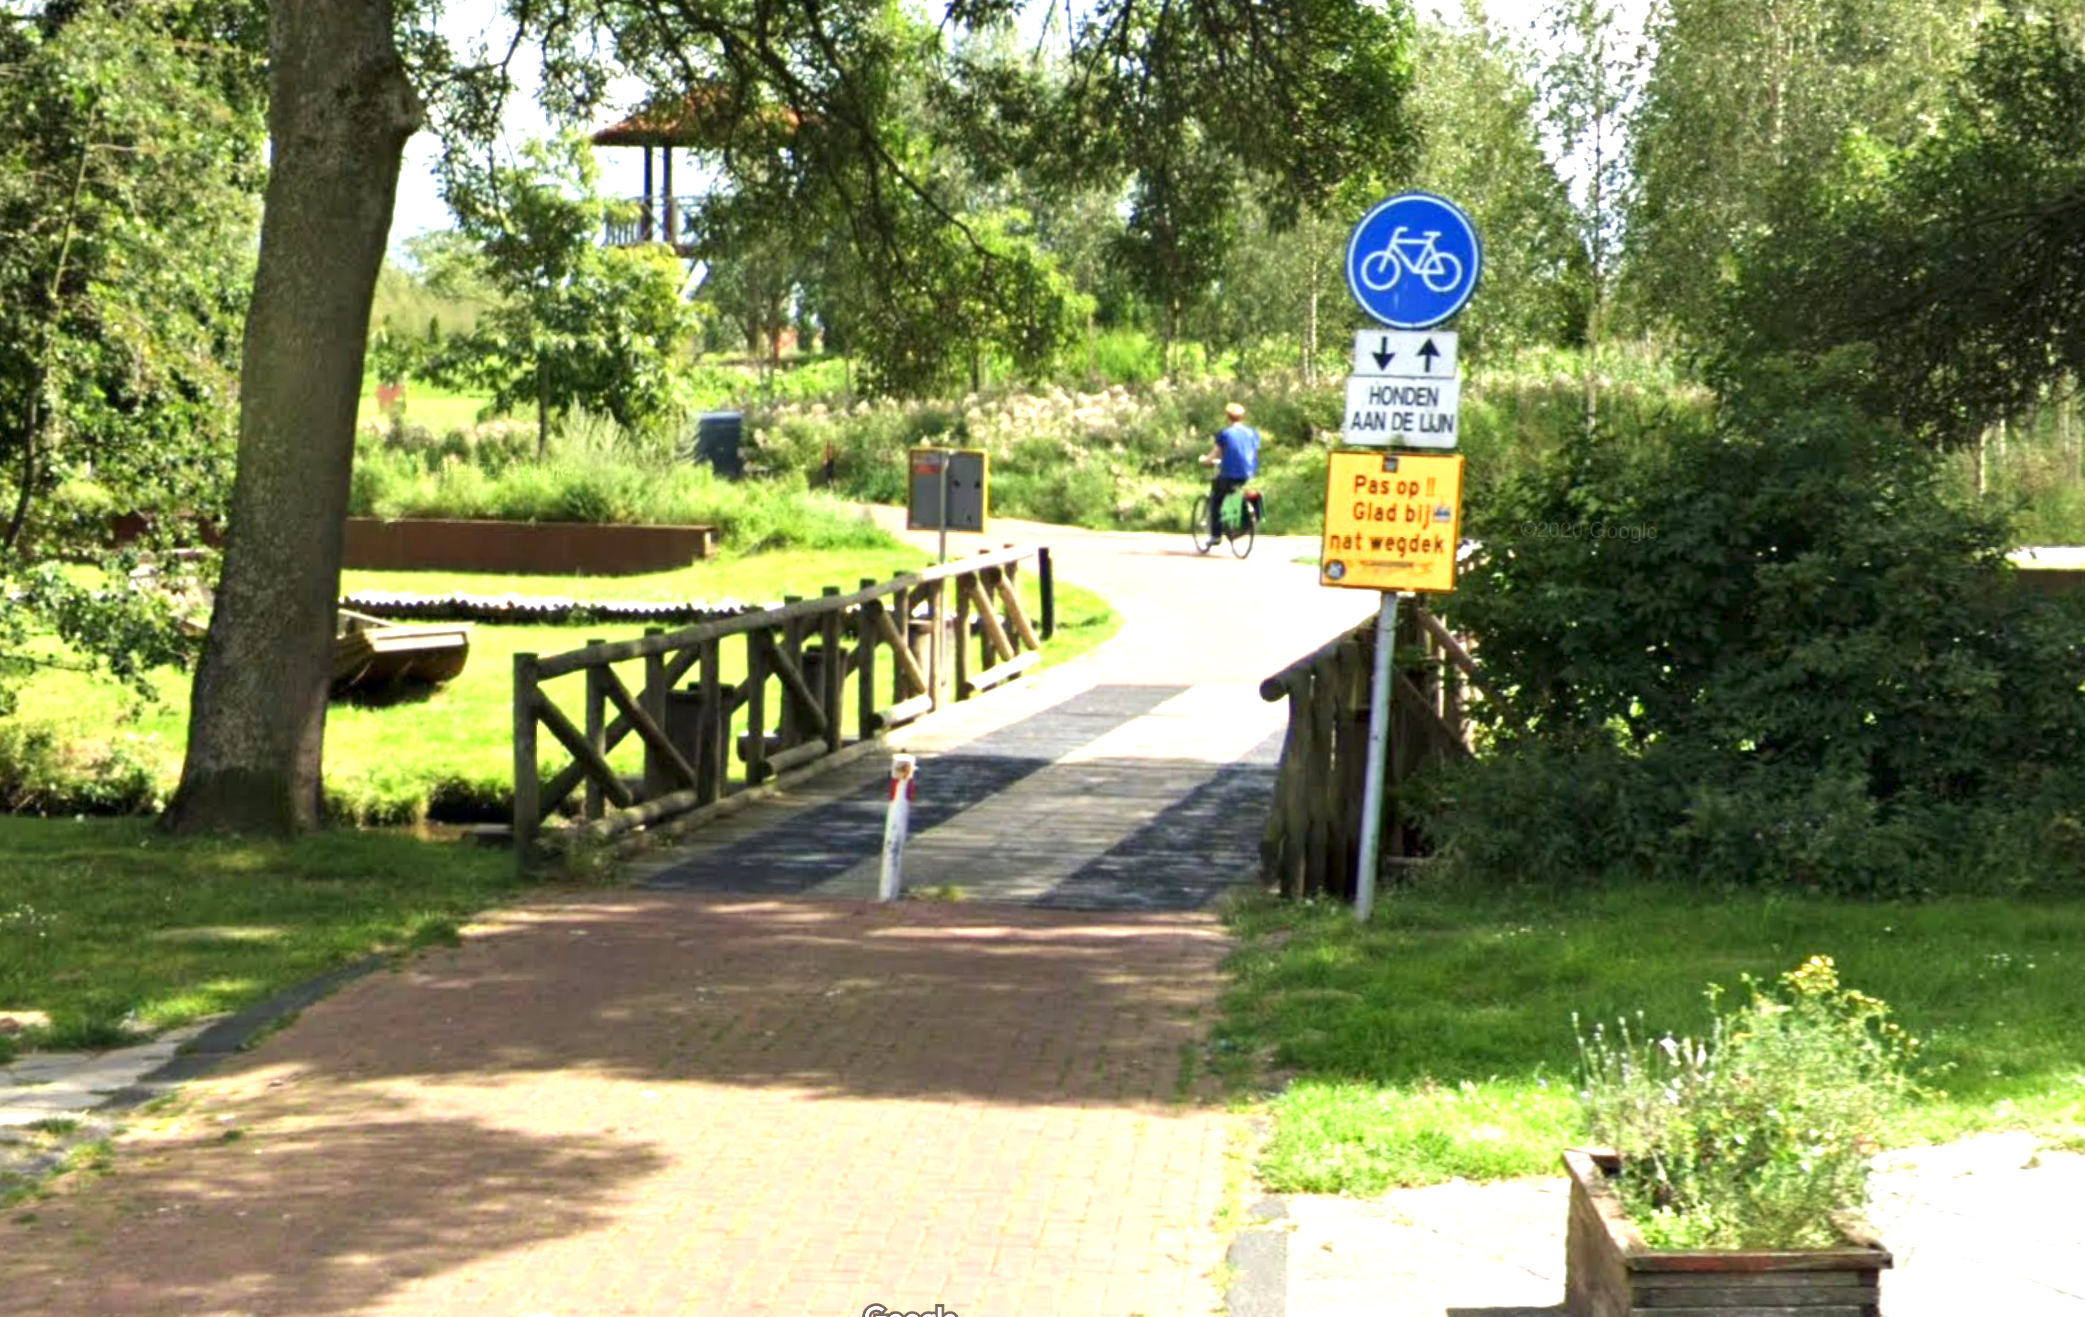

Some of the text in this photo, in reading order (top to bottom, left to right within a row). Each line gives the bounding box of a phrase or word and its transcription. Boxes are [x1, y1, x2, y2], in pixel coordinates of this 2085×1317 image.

[1369, 386, 1439, 407] HONDEN
[1351, 411, 1455, 433] AAN DE LIJN
[1354, 474, 1390, 494] Pas
[1396, 480, 1420, 499] op
[1353, 501, 1431, 530] Glad bij
[1329, 532, 1444, 558] nat wegdek
